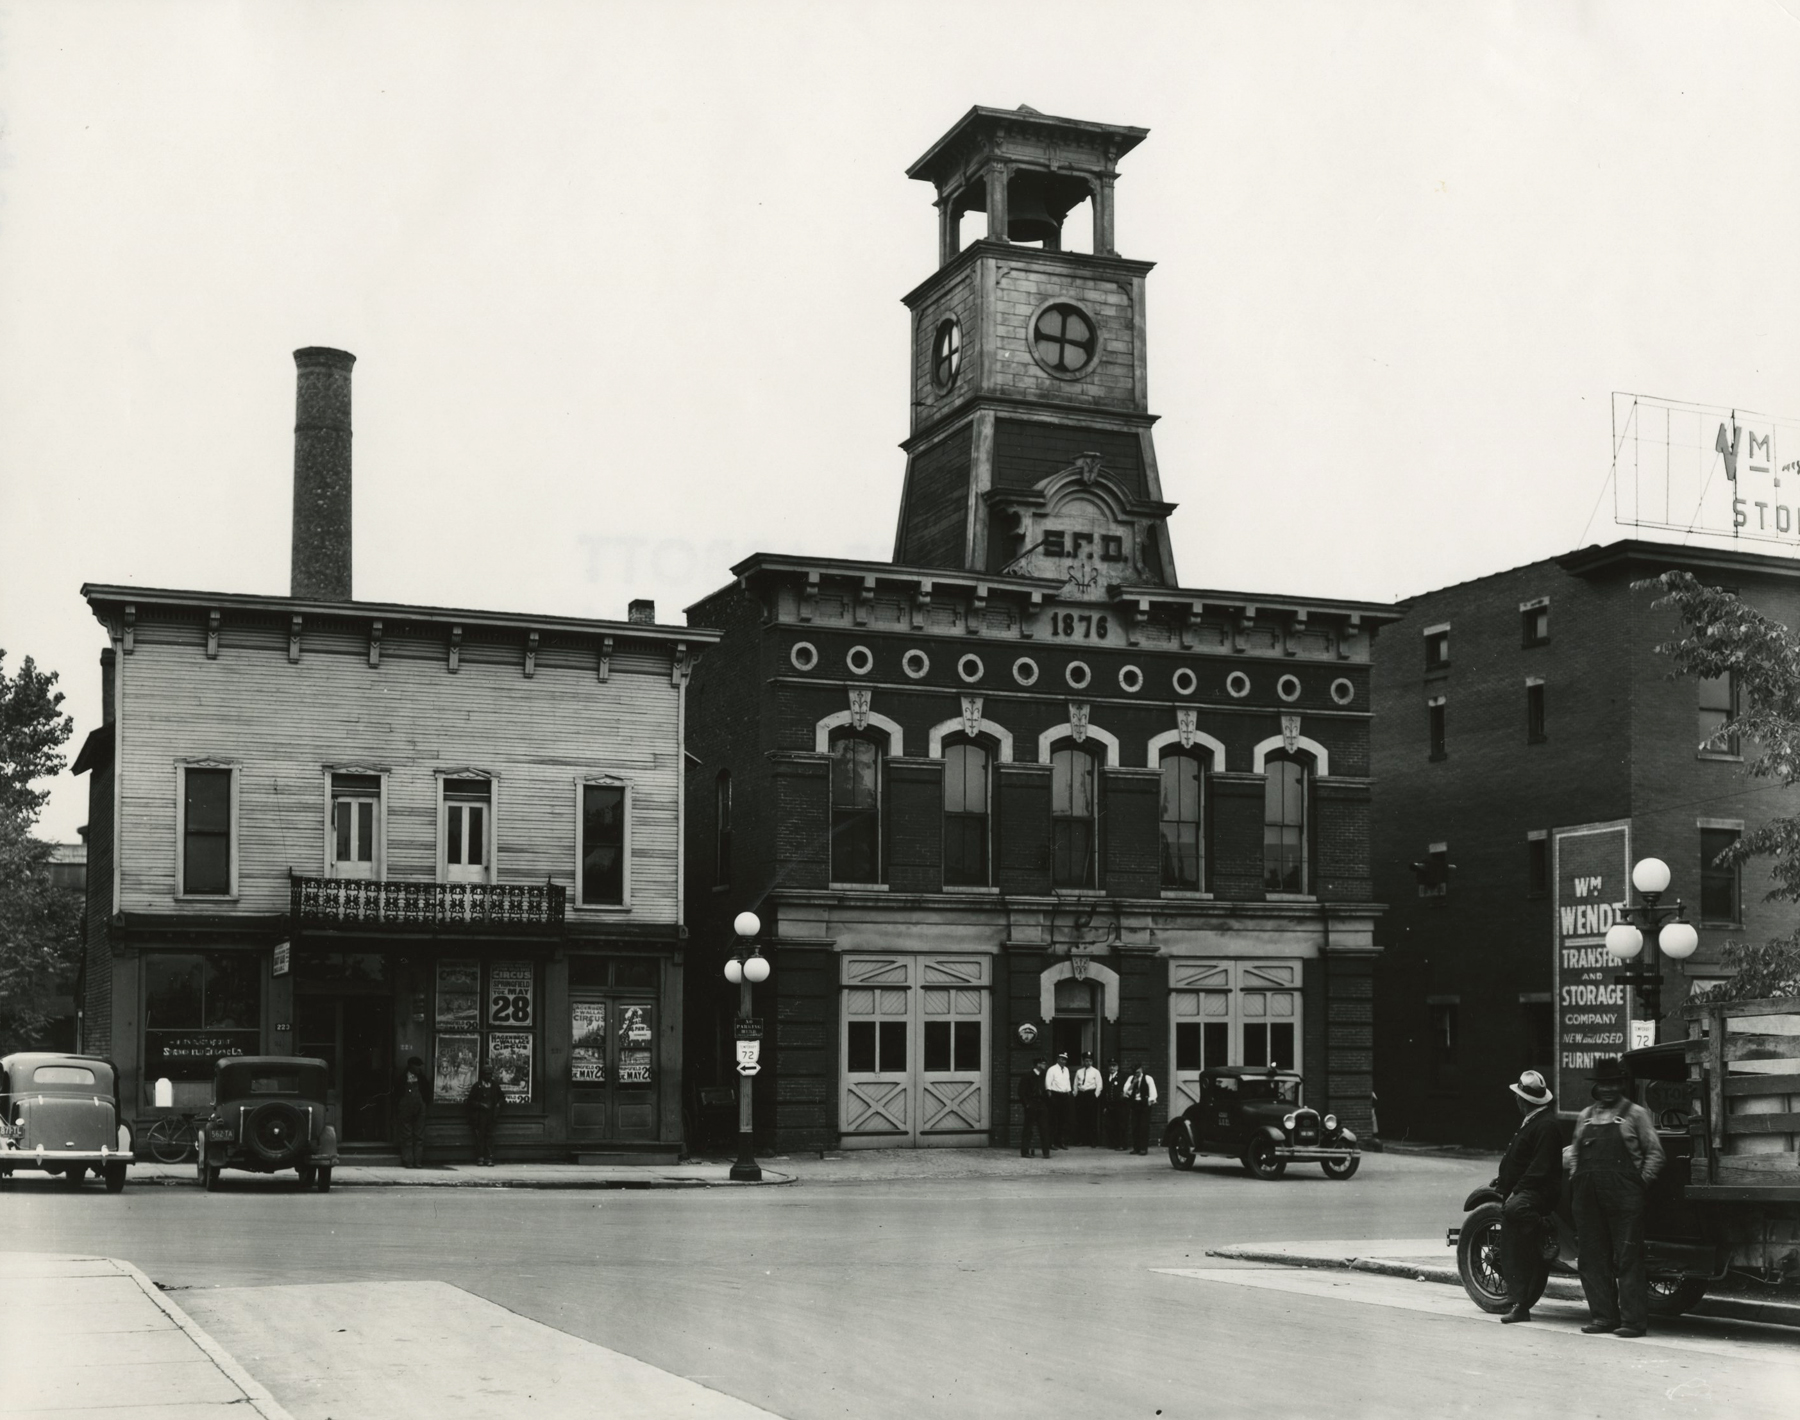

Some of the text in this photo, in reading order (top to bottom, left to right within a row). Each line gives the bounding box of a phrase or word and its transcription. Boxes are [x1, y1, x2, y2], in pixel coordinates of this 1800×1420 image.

[1733, 498, 1800, 536] STO
[1043, 529, 1129, 563] S.F.D.
[1051, 612, 1108, 639] 1876
[1560, 902, 1625, 936] WENDT
[1562, 948, 1623, 969] TRANSFER
[492, 971, 531, 979] CIRCUS
[1581, 972, 1603, 981] AND
[493, 980, 530, 988] SPRINGFIELD
[1562, 984, 1624, 1006] STORAGE
[492, 995, 530, 1022] 28
[573, 1014, 605, 1022] CIRCUS
[1565, 1013, 1618, 1025] COMPANY
[1562, 1033, 1583, 1044] NEW
[1596, 1033, 1624, 1044] USED
[1636, 1034, 1650, 1047] 72
[741, 1050, 755, 1060] 72
[579, 1070, 594, 1079] MAY
[627, 1071, 642, 1080] MAY
